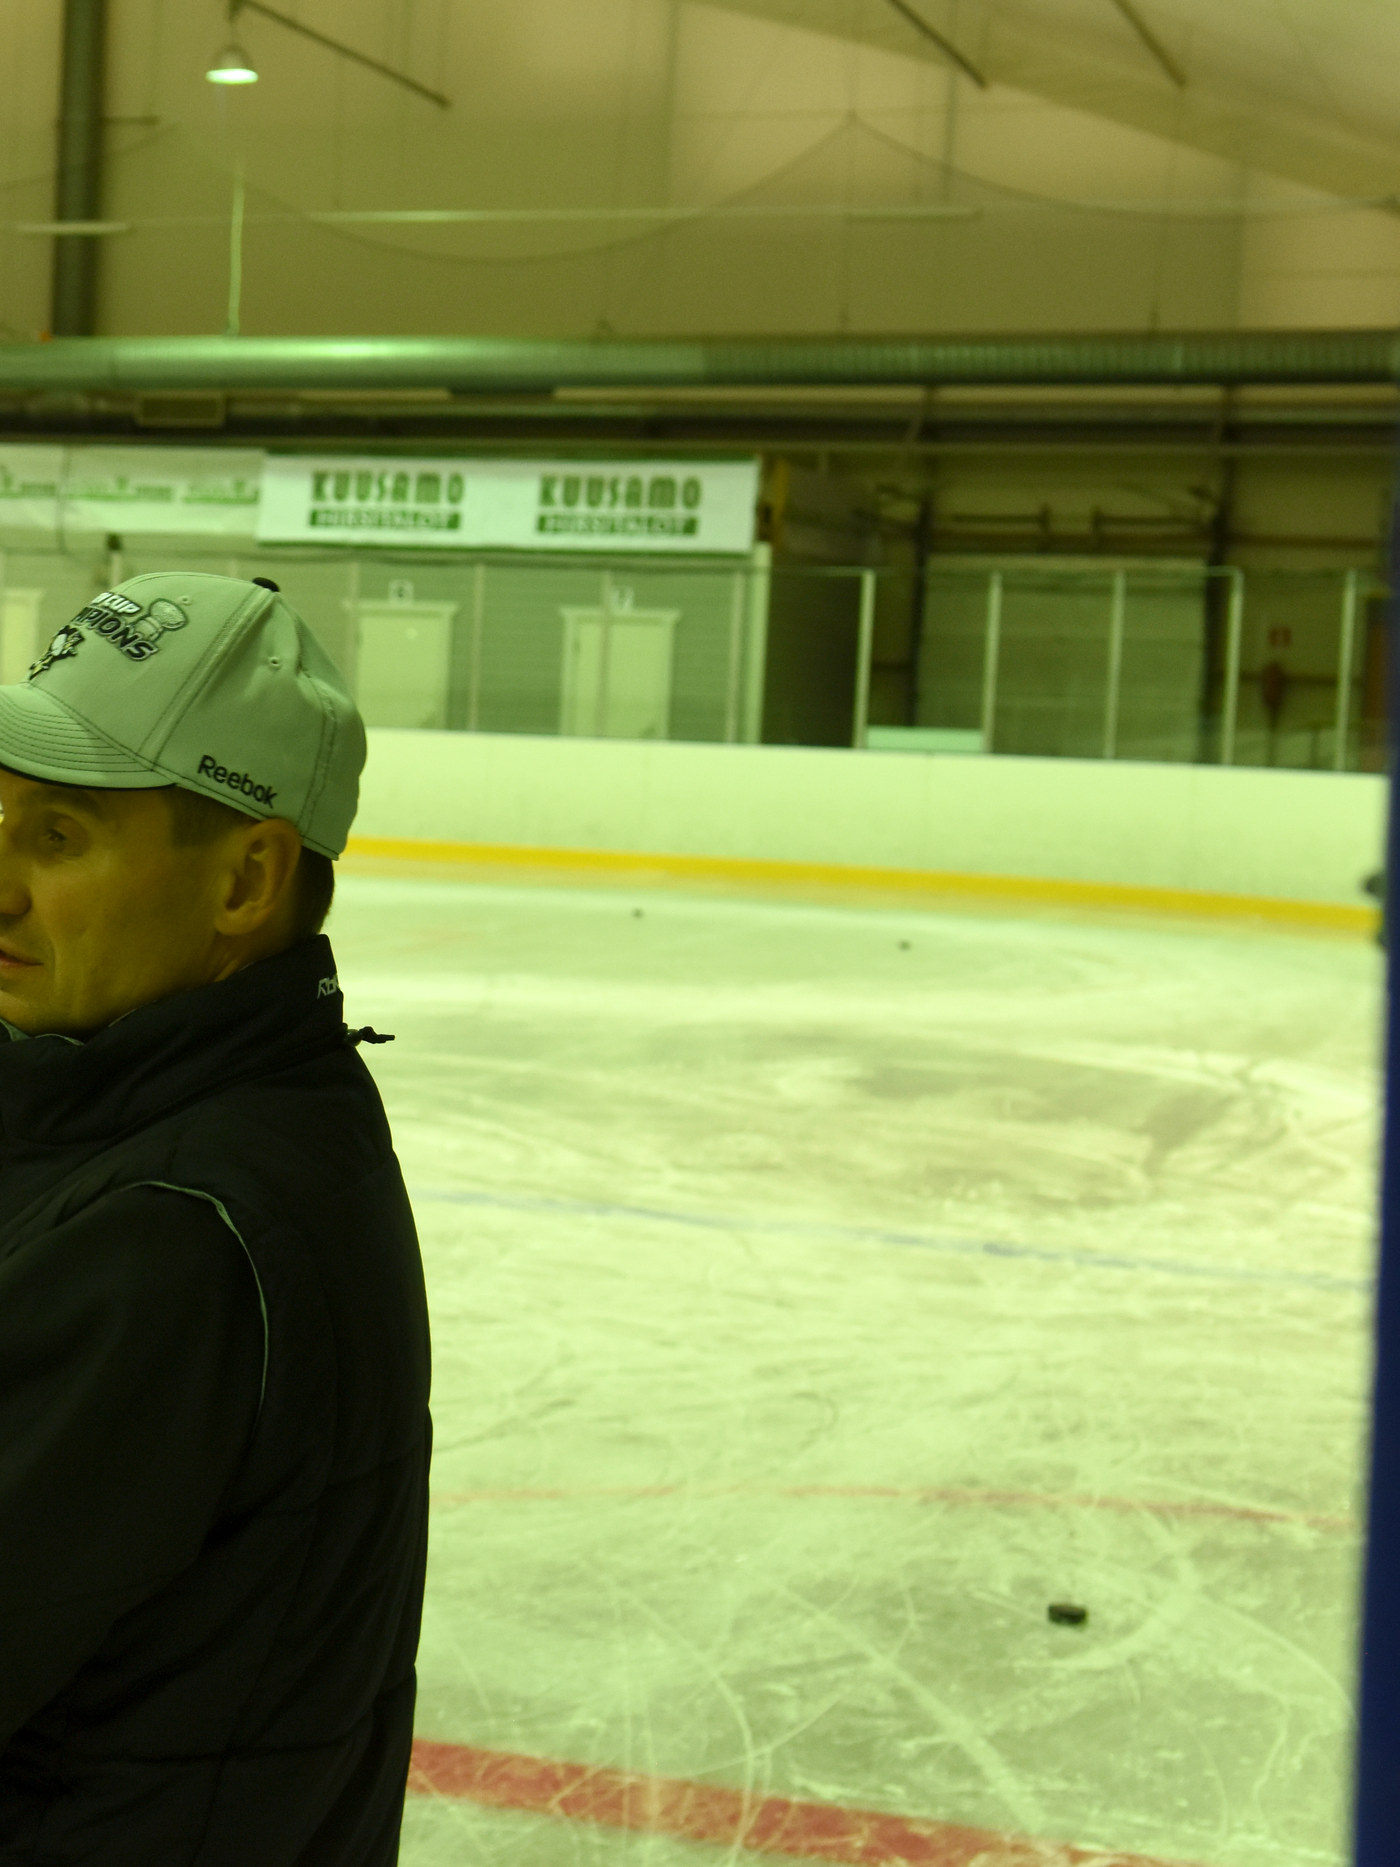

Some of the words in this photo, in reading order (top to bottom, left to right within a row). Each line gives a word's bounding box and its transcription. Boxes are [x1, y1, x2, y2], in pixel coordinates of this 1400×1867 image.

[312, 470, 464, 504] KUUSAMO
[540, 475, 701, 509] KUUSAMO
[197, 754, 278, 809] Reebok
